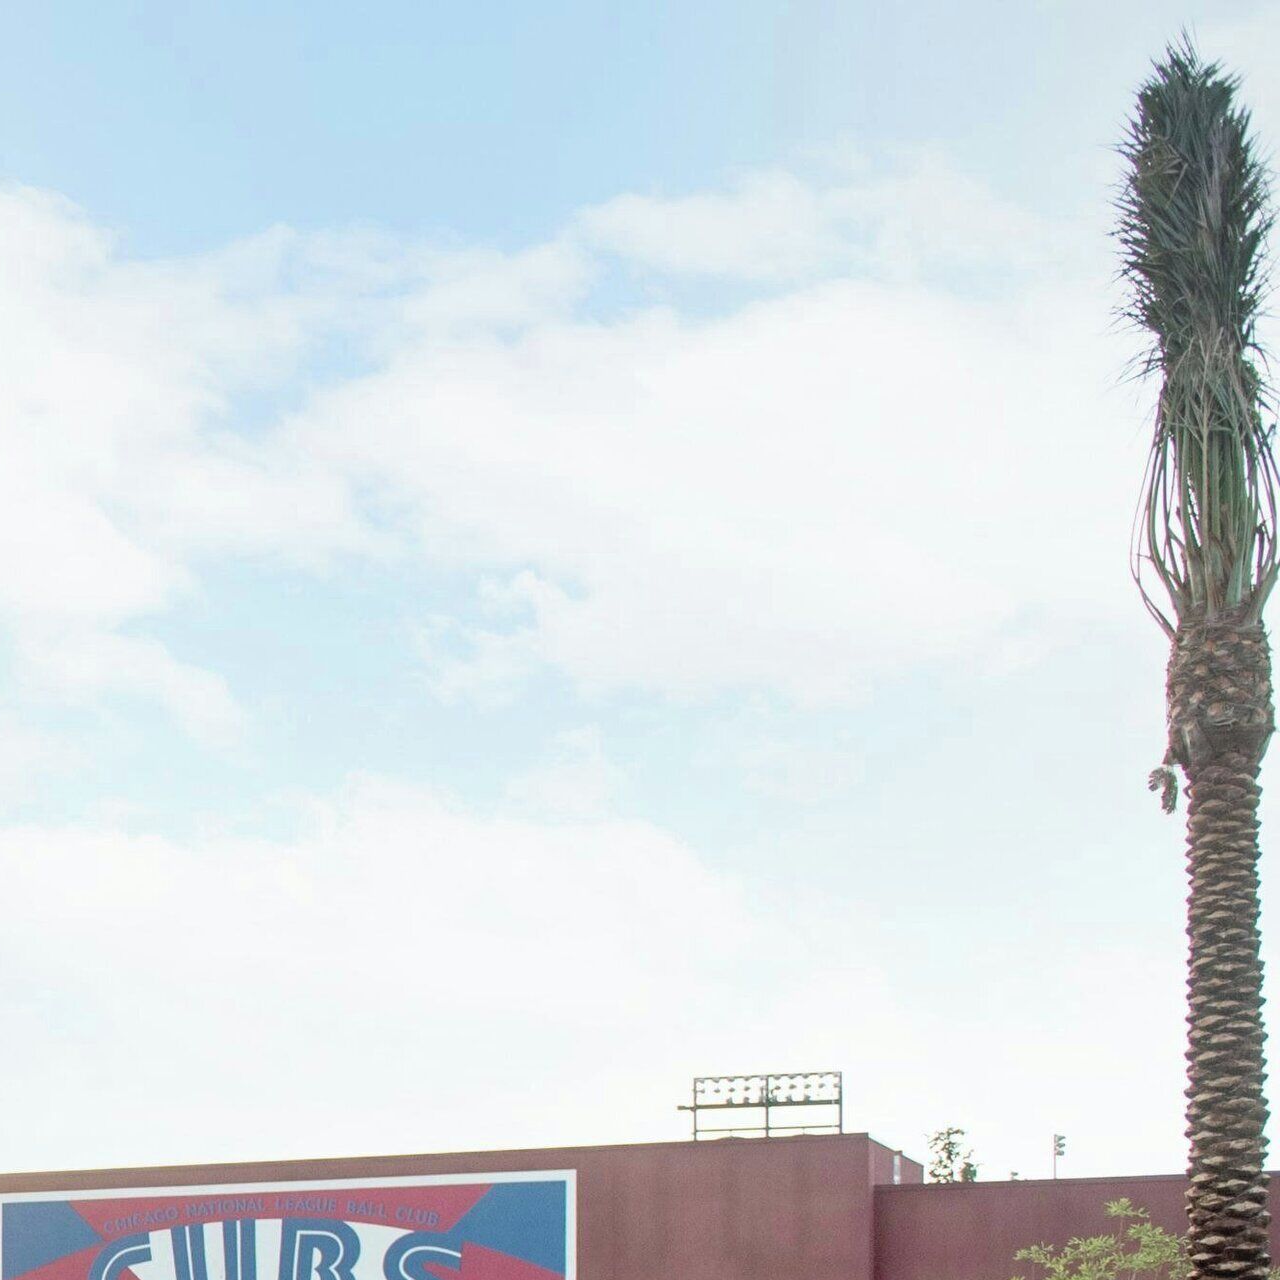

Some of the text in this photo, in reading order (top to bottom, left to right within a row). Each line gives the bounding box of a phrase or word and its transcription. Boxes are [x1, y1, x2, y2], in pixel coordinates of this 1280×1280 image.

[103, 1197, 439, 1233] CHICAGO NATIONAL LEAGUE BALL CLUB
